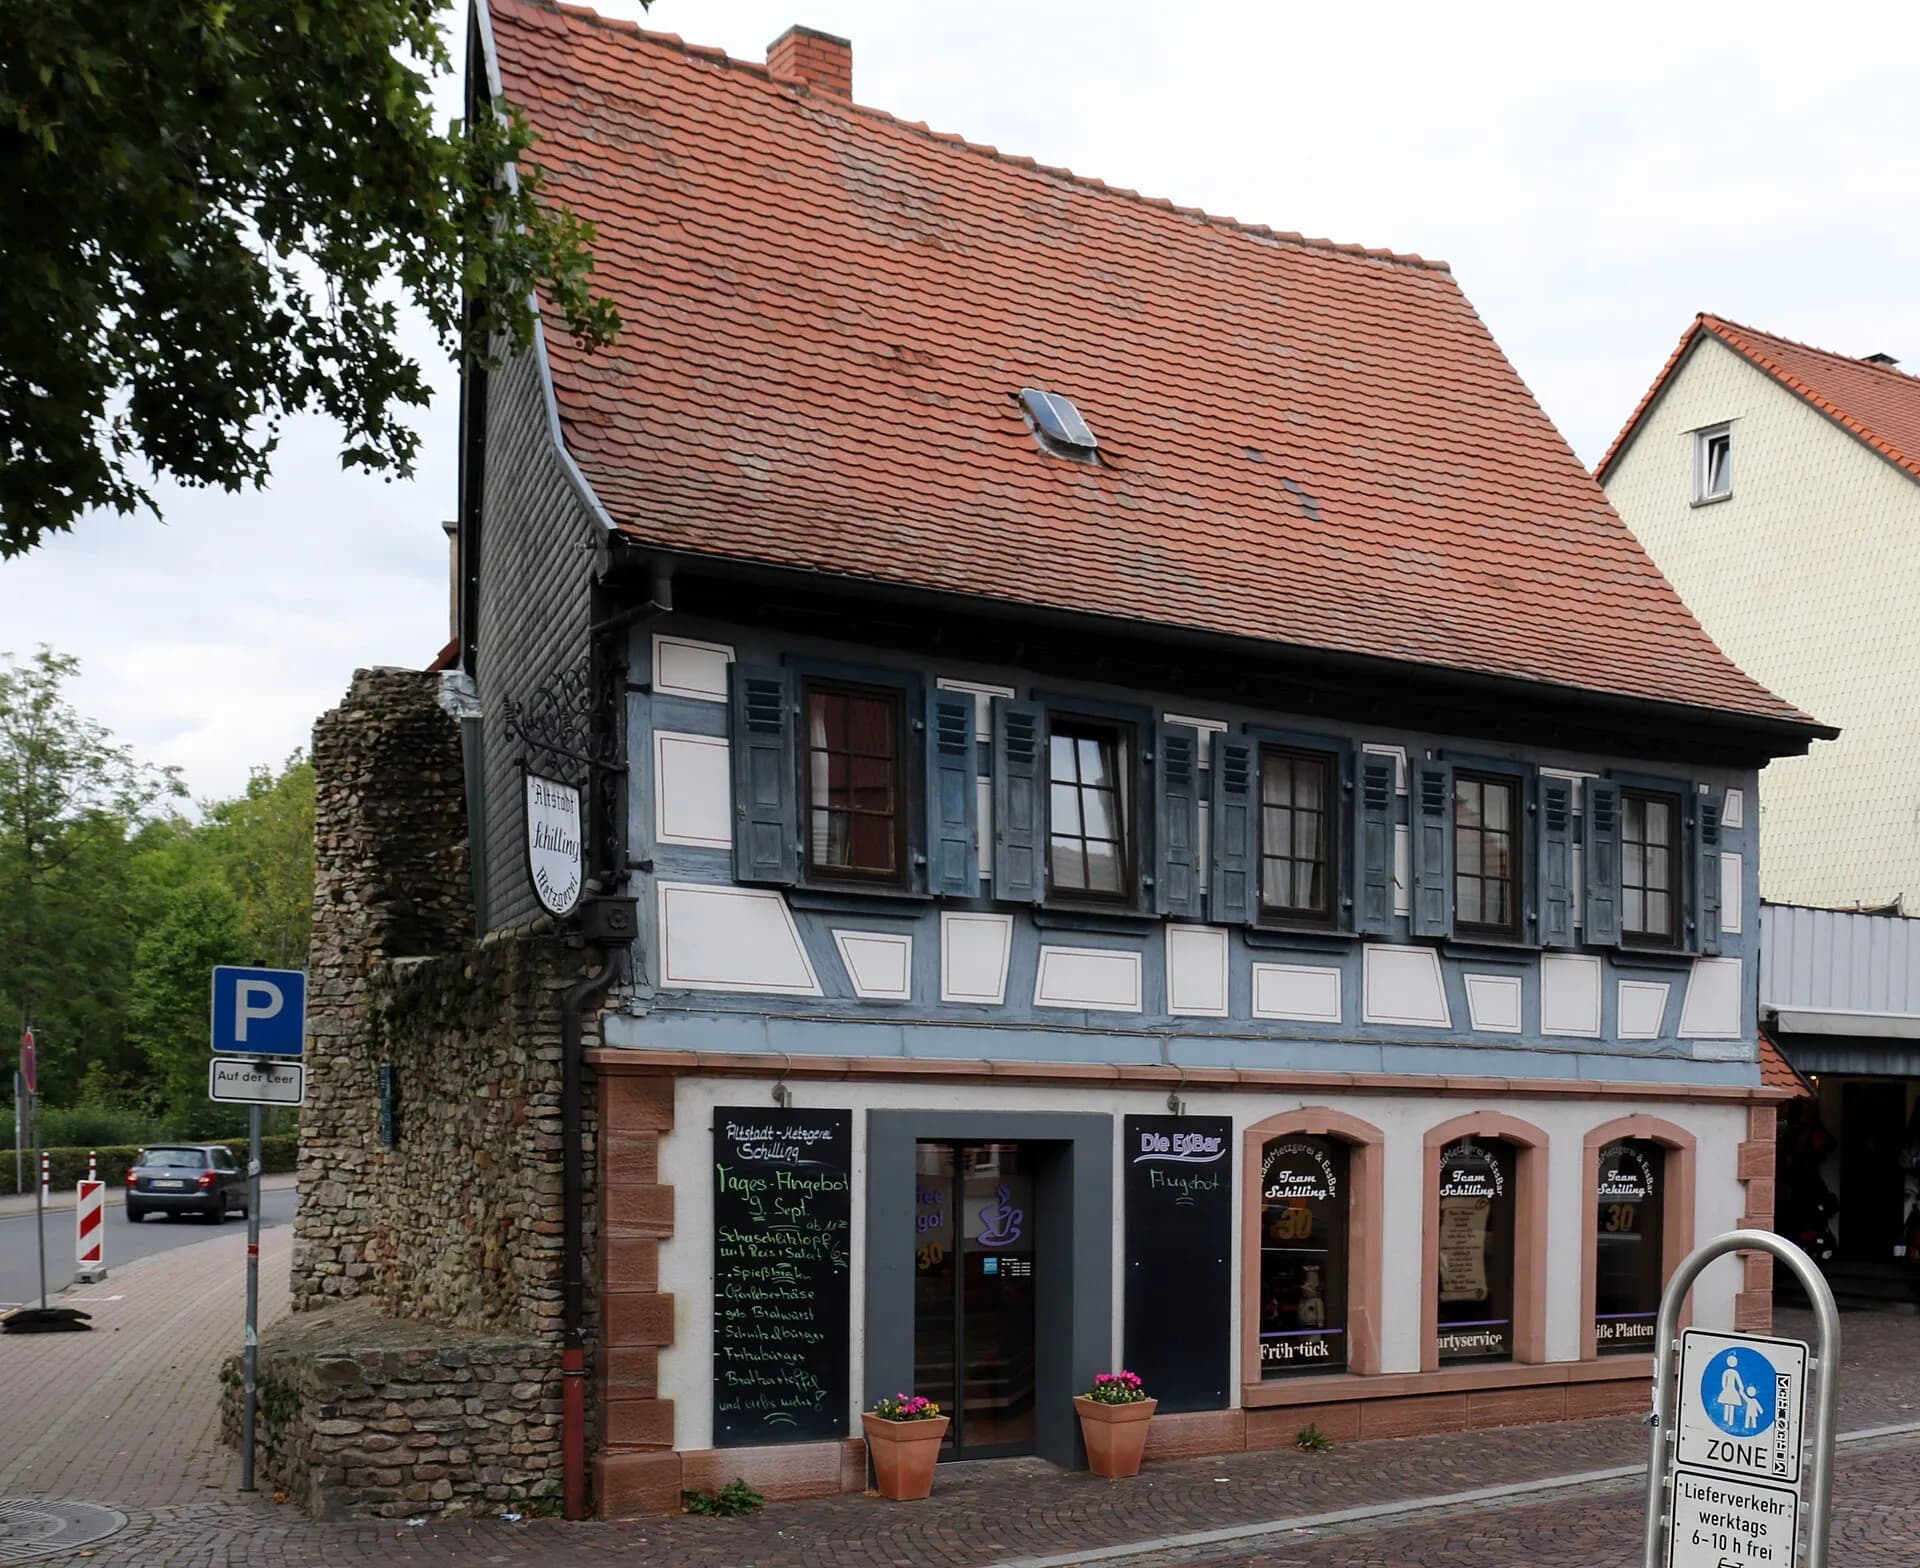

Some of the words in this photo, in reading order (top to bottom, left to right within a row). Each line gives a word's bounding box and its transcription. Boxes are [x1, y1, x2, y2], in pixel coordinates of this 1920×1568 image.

[234, 978, 284, 1042] P
[217, 1070, 239, 1081] Auf
[242, 1072, 263, 1083] der
[267, 1072, 294, 1084] Leer
[1141, 1133, 1169, 1152] Die
[736, 1142, 800, 1166] Schilling
[1279, 1170, 1317, 1183] Team
[1452, 1170, 1486, 1182] Team
[1607, 1170, 1638, 1182] Team
[1265, 1185, 1328, 1200] Schilling
[1440, 1184, 1495, 1199] Schilling
[1598, 1183, 1645, 1198] Schilling
[1615, 1323, 1654, 1338] Platten
[1706, 1439, 1768, 1469] ZONE
[1685, 1482, 1786, 1516] Lieferverkehr
[1699, 1512, 1768, 1538] werktags
[1733, 1537, 1741, 1554] h
[1747, 1540, 1773, 1561] frei
